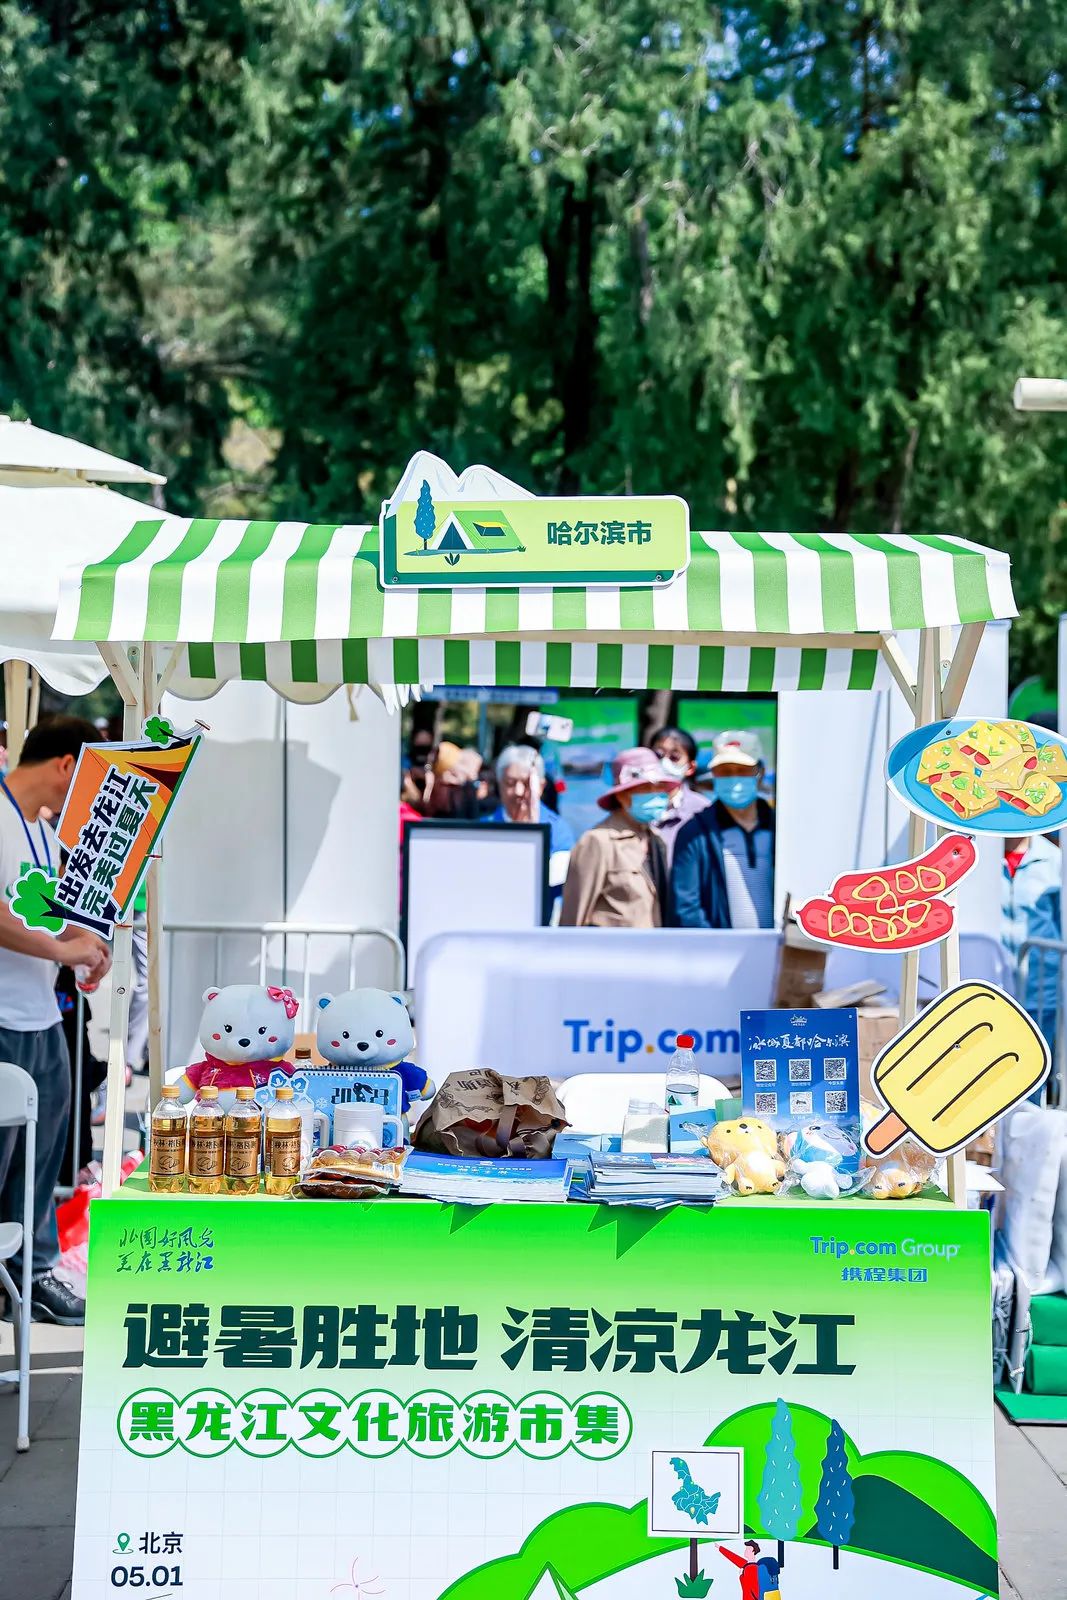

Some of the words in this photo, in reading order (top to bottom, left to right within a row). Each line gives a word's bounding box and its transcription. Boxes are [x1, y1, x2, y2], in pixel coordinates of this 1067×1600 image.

[546, 520, 652, 545] 哈尔滨市
[57, 767, 132, 908] 出发去龙江
[80, 777, 157, 918] 完美过夏天
[563, 1019, 741, 1062] Trip.com
[809, 1236, 897, 1259] Trip.com
[901, 1238, 960, 1262] Group
[842, 1267, 928, 1283] 携程集团
[122, 1303, 479, 1370] 避暑胜地
[500, 1306, 857, 1375] 清凉龙江
[128, 1401, 620, 1445] 黑龙江文化旅游市集
[139, 1531, 184, 1554] 北京
[111, 1566, 183, 1587] 05.01
